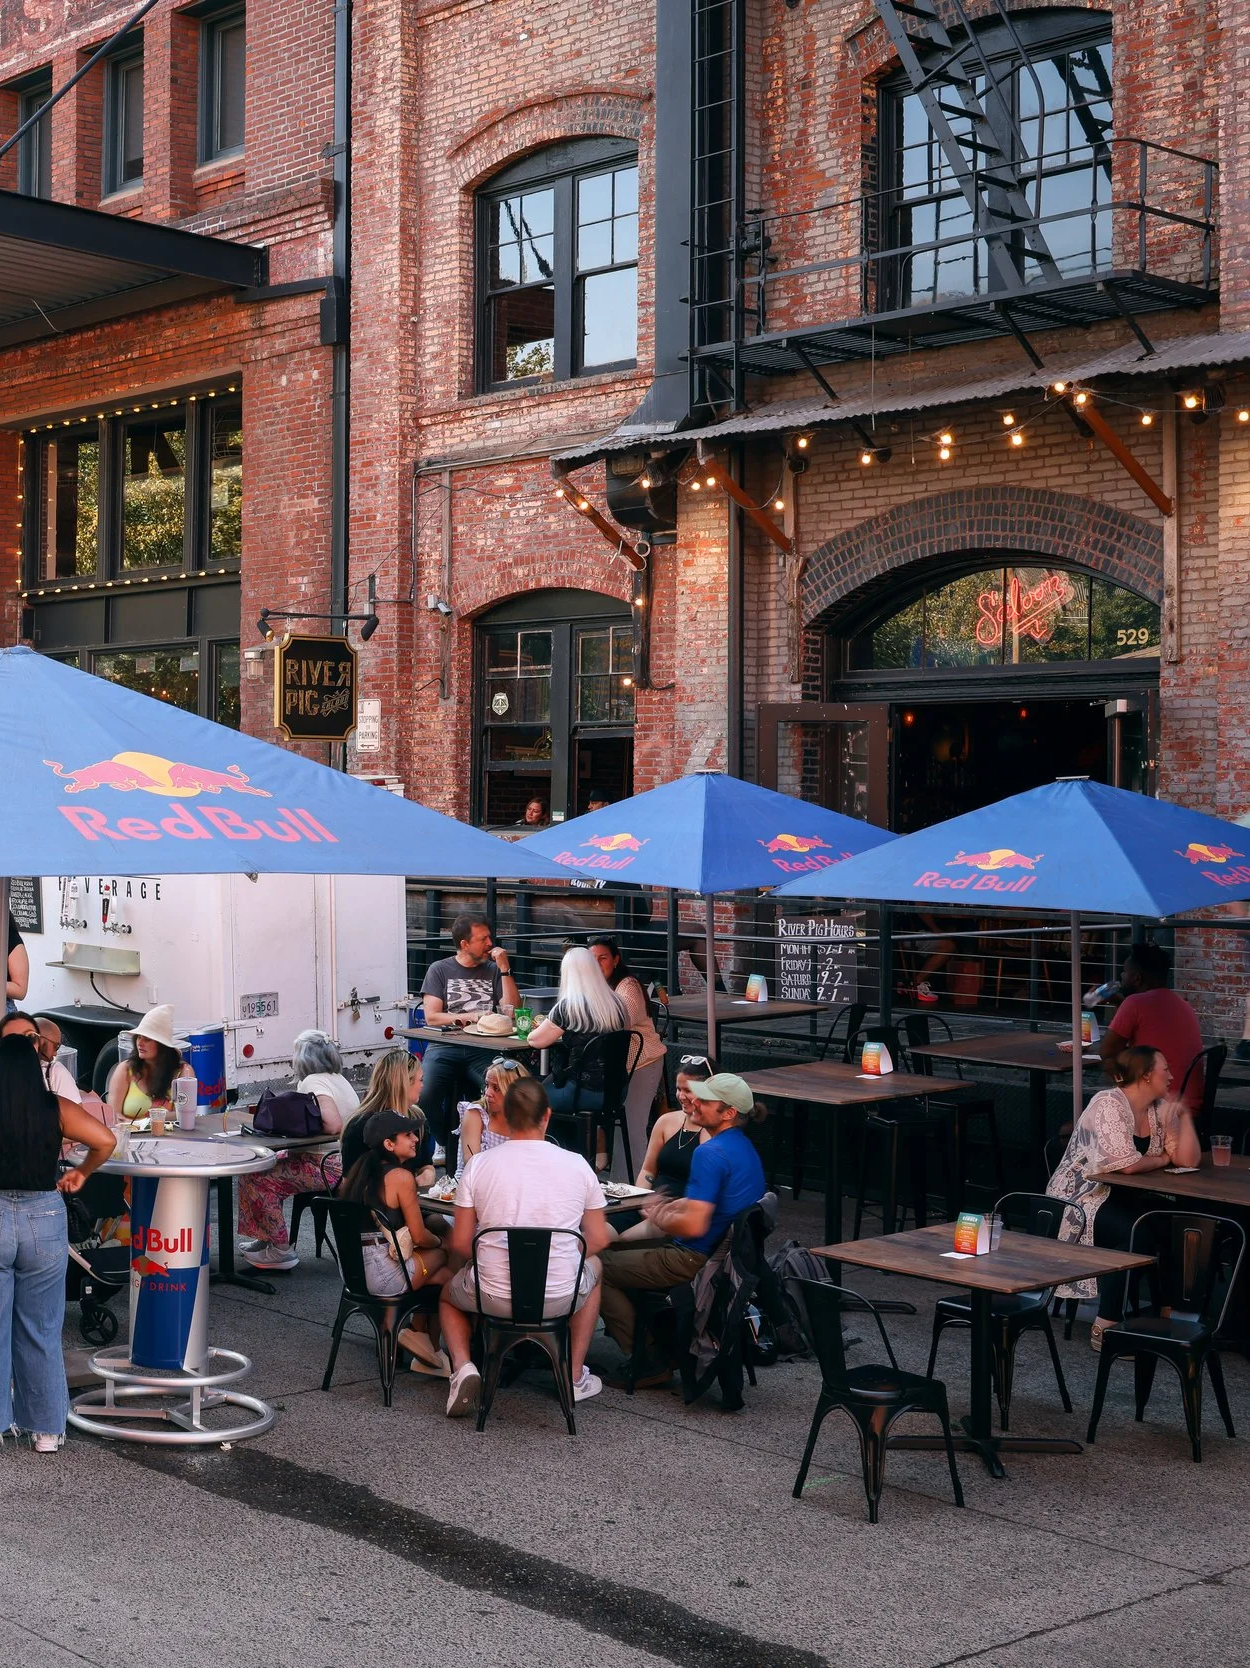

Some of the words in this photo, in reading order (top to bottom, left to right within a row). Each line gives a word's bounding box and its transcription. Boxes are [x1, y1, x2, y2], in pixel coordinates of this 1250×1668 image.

[976, 576, 1065, 644] Saloon
[1116, 628, 1149, 646] 529
[285, 658, 351, 687] RIVER
[285, 689, 320, 716] PIG
[358, 715, 378, 724] STOPPING
[358, 731, 378, 740] PARKING
[56, 803, 214, 841] Red
[196, 806, 340, 843] Bull
[552, 851, 597, 868] Red
[589, 853, 637, 871] Bull
[771, 856, 823, 873] Red
[913, 871, 979, 890] Red
[971, 875, 1038, 894] Bull
[1200, 866, 1250, 887] Red
[59, 877, 161, 901] VERAGE
[777, 918, 806, 937] RIVER
[807, 919, 824, 937] PIG
[824, 918, 855, 938] HOURS
[781, 957, 806, 971] FRIDAY
[780, 971, 819, 986] SATURD
[781, 987, 811, 1000] SUNDA
[147, 1227, 193, 1254] Bull
[150, 1281, 187, 1292] DRINK
